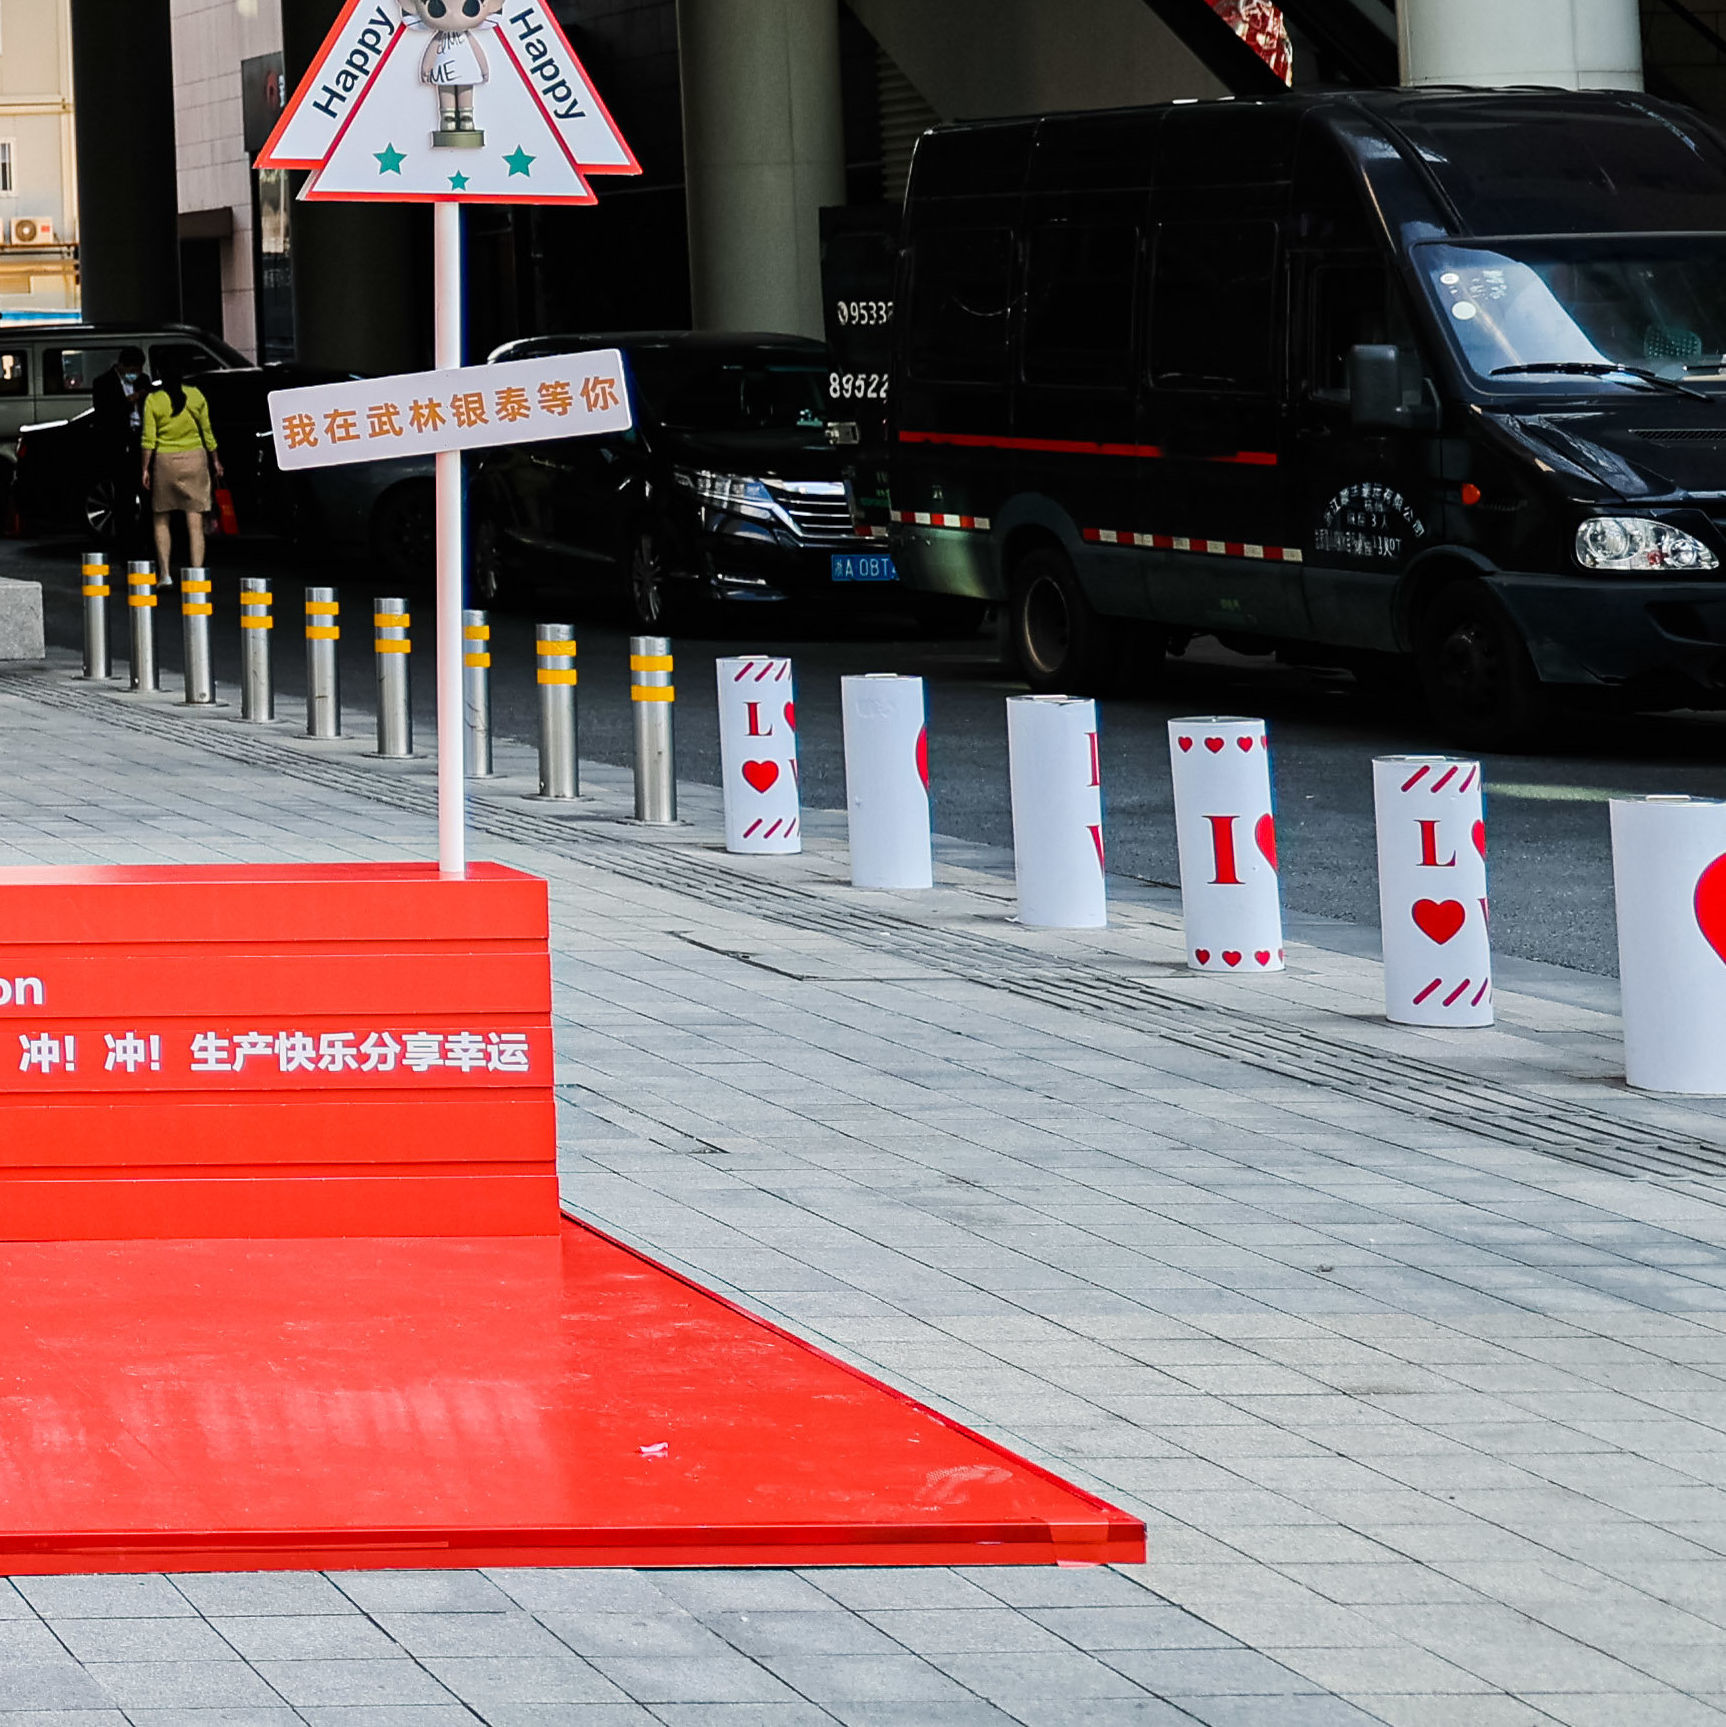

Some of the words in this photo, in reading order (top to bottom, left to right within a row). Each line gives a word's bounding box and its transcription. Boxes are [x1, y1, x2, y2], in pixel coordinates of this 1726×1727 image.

[312, 5, 395, 119] Happy
[508, 7, 588, 122] Happy
[280, 375, 621, 451] 我在武林银泰等你
[742, 701, 774, 737] L
[1202, 815, 1247, 885] I
[1413, 819, 1457, 867] L
